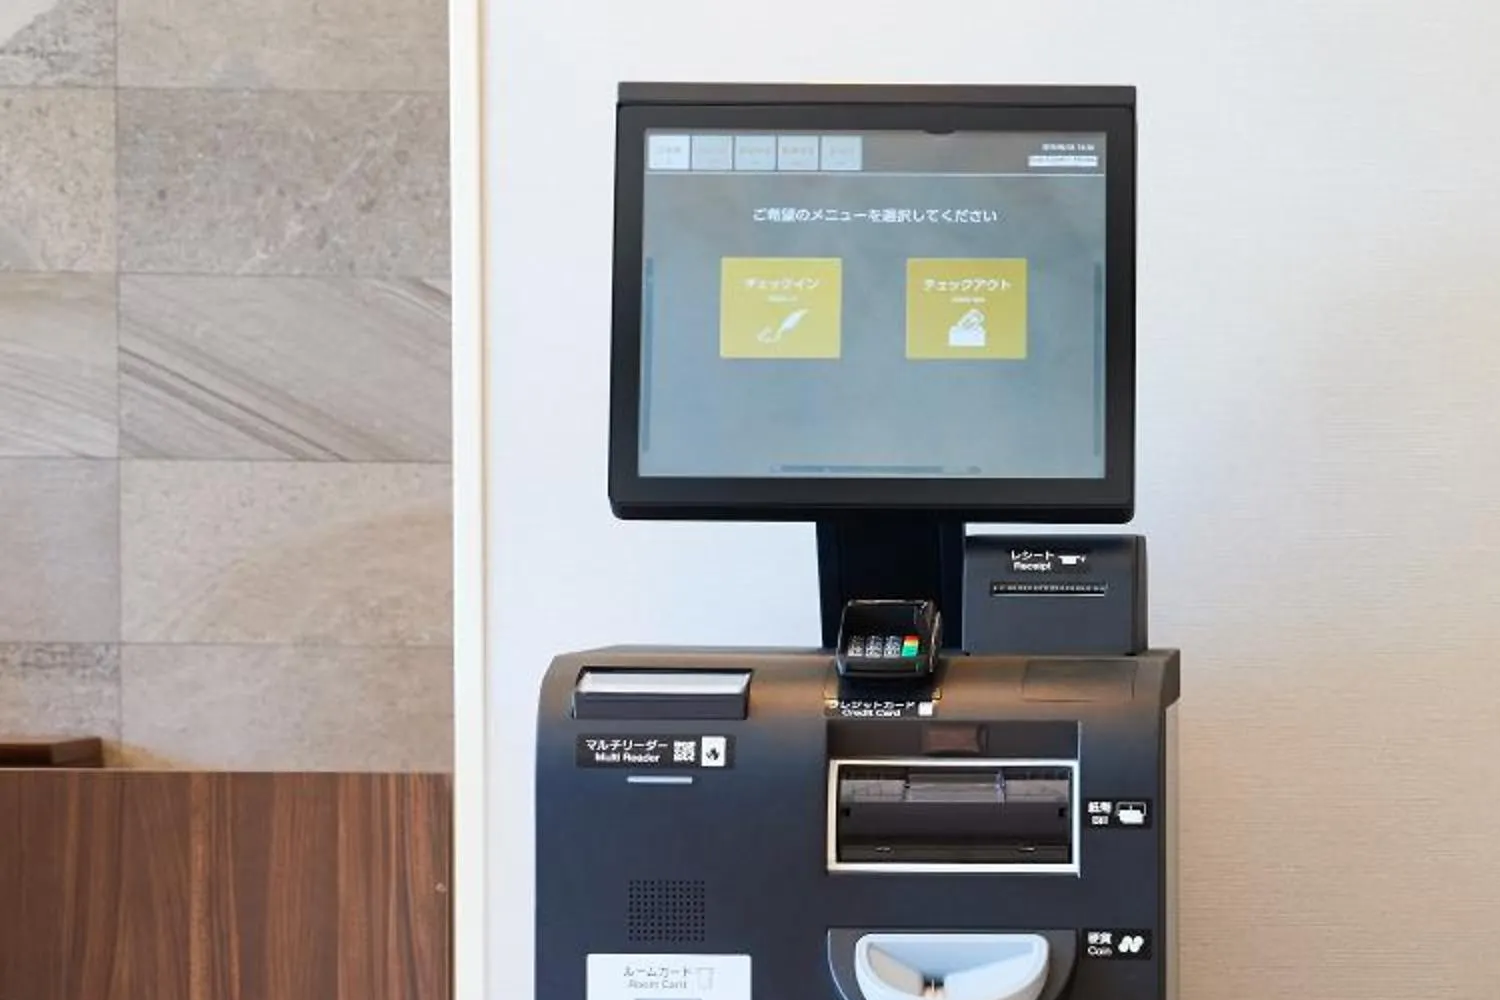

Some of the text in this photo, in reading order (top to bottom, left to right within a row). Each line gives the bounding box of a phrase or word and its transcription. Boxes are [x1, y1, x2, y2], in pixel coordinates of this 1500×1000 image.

[753, 207, 998, 223] ご希望のメニューを選択してください
[923, 278, 1011, 293] チェックアウト
[1011, 550, 1054, 560] レシート
[1013, 561, 1051, 571] Receipt
[876, 709, 901, 717] Card
[585, 739, 668, 751] マルチリーダー
[595, 752, 660, 763] Multi Reader
[623, 965, 689, 978] ルームカード
